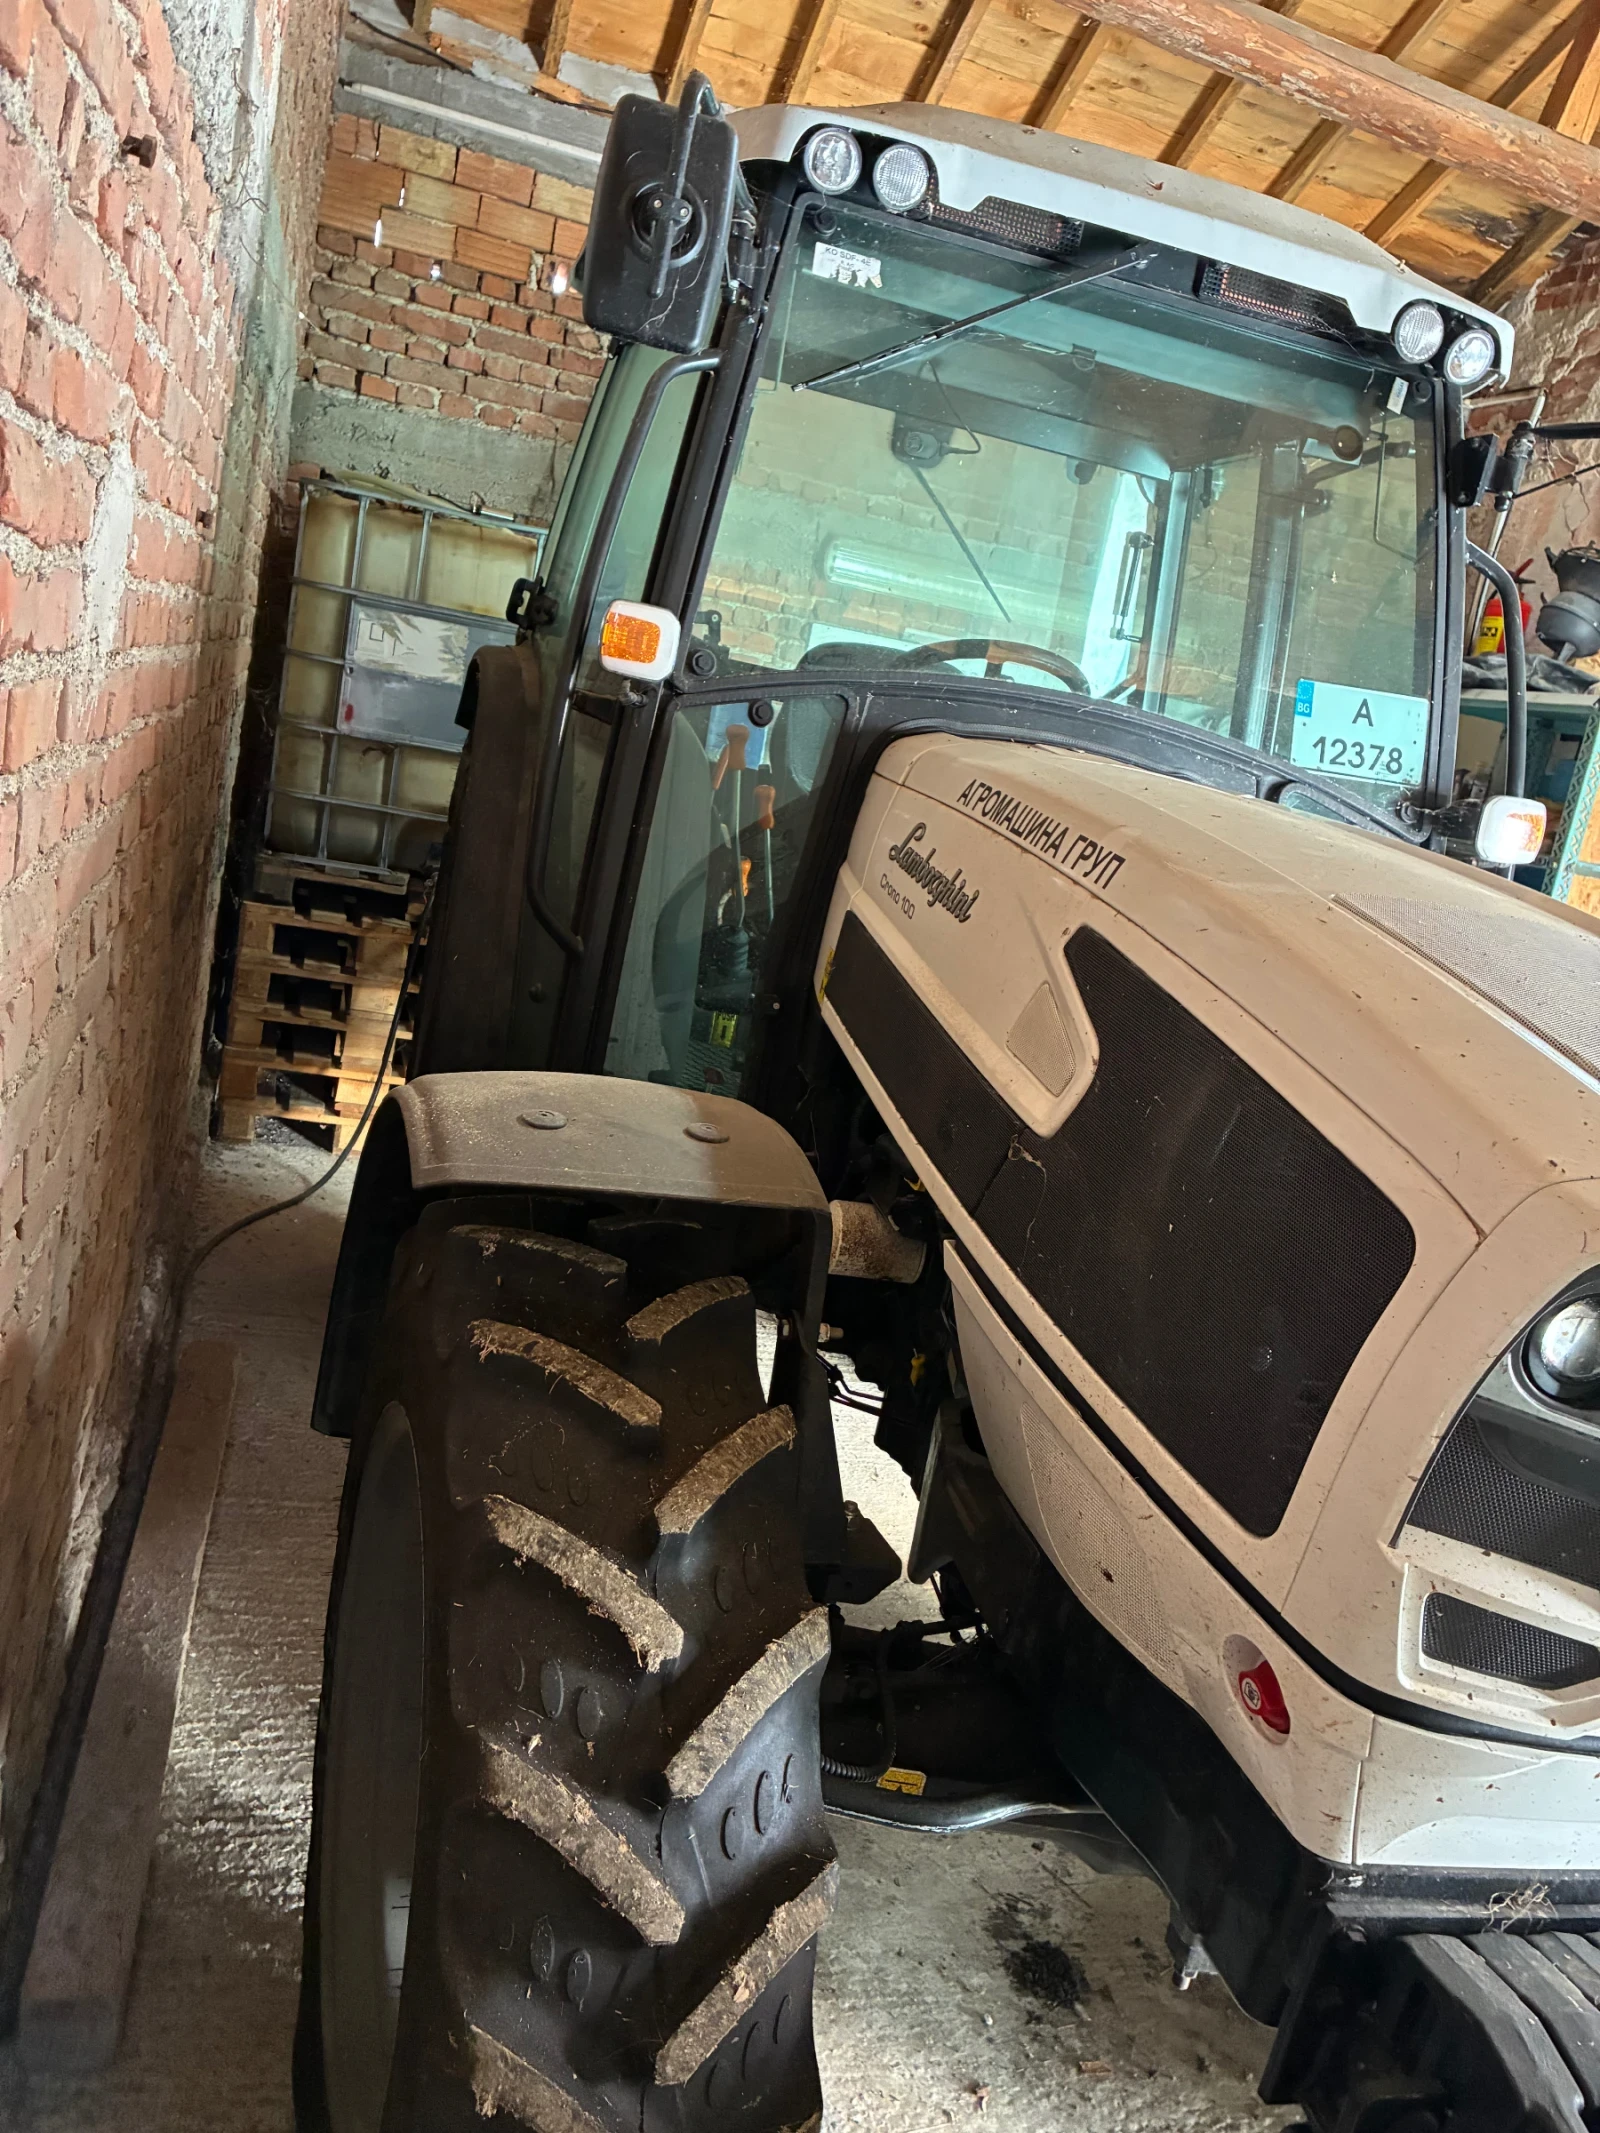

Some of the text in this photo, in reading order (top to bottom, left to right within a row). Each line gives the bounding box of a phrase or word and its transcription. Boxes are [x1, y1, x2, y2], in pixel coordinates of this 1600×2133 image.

[1297, 703, 1310, 714] BG
[1352, 698, 1374, 727] A
[1312, 736, 1403, 775] 12378
[956, 779, 1127, 890] АГРОМАШИНА ГРУП
[888, 822, 980, 924] Lamborghini
[880, 873, 916, 920] Crono 100
